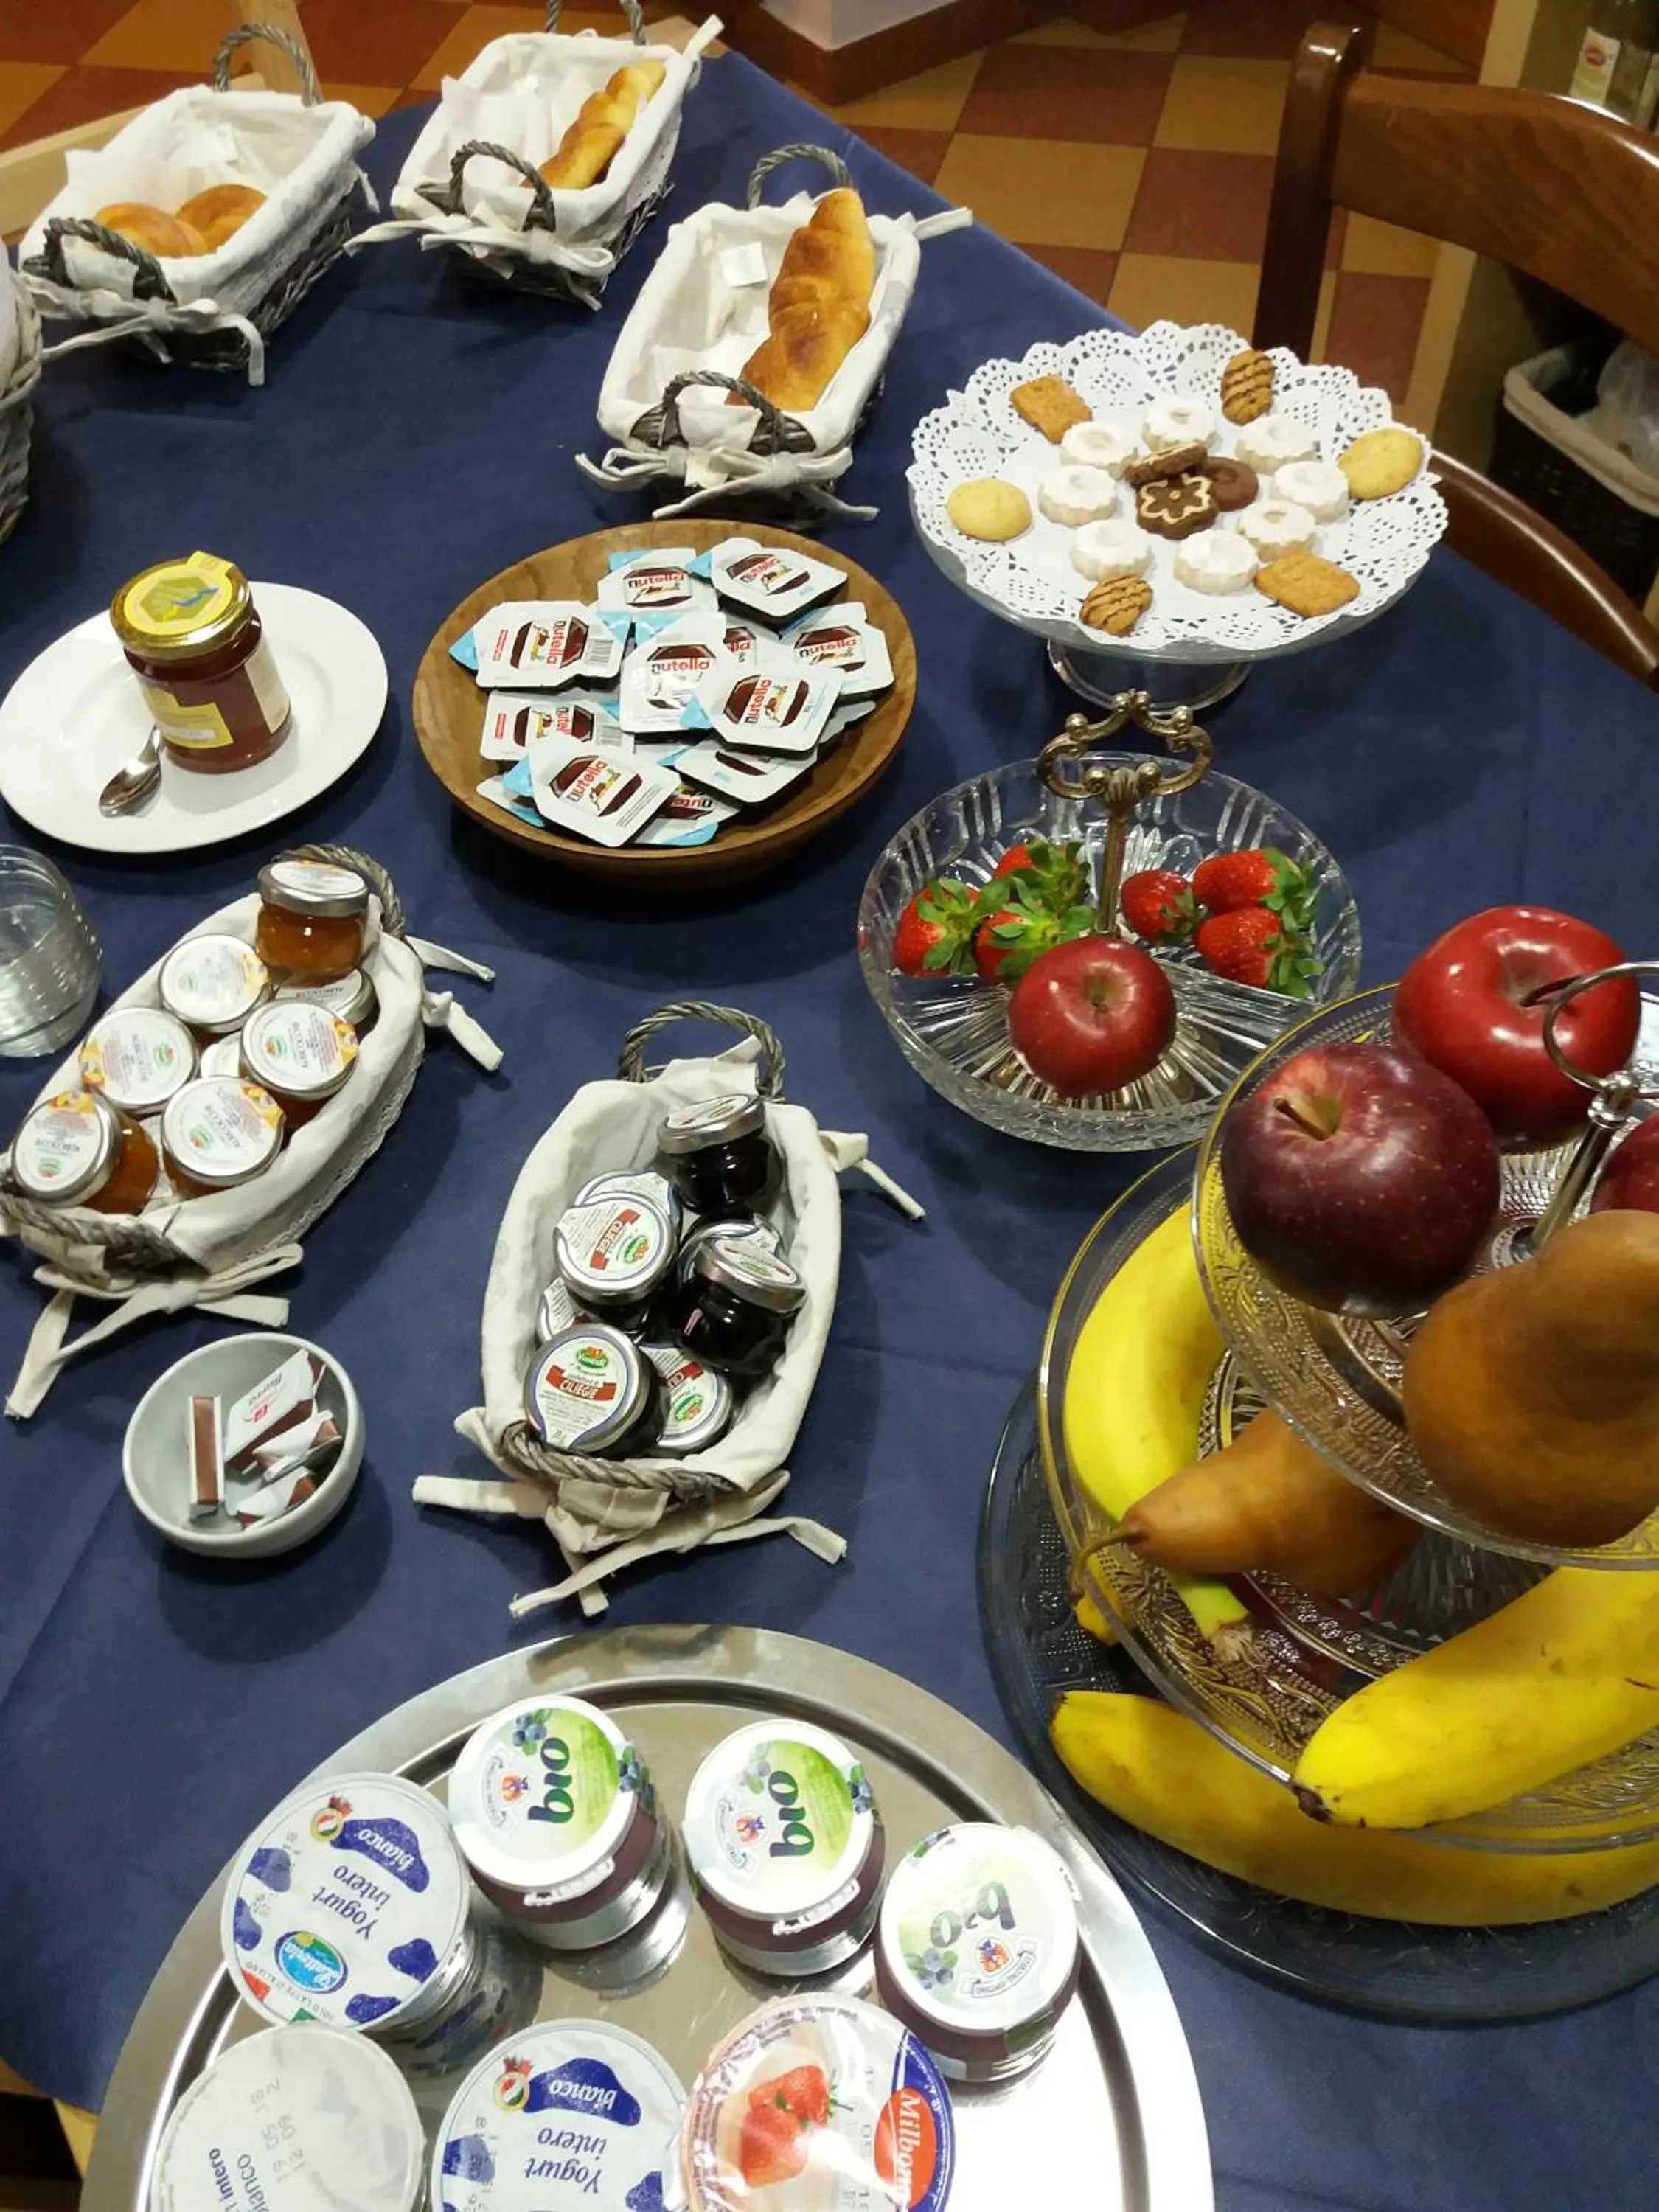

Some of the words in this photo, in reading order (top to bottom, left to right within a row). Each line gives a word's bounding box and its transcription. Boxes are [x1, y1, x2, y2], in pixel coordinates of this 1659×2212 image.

[628, 573, 685, 588] nutella
[546, 620, 567, 664] nutella
[799, 637, 858, 658] nutella
[651, 656, 710, 675] nutella
[745, 679, 773, 723] nutella
[567, 760, 608, 802] nutella
[560, 1380, 599, 1399] CILIEGIE
[527, 1736, 574, 1824] bio
[769, 1770, 815, 1858] bio
[358, 1828, 415, 1873] bianco
[333, 1865, 392, 1912] intero
[312, 1887, 378, 1940] Yogurt
[929, 1882, 1016, 1949] bio
[549, 2079, 618, 2110] bianco
[538, 2128, 608, 2161] intero
[209, 2147, 234, 2202] intero
[237, 2154, 271, 2212] ianco
[524, 2158, 602, 2194] Yogurt
